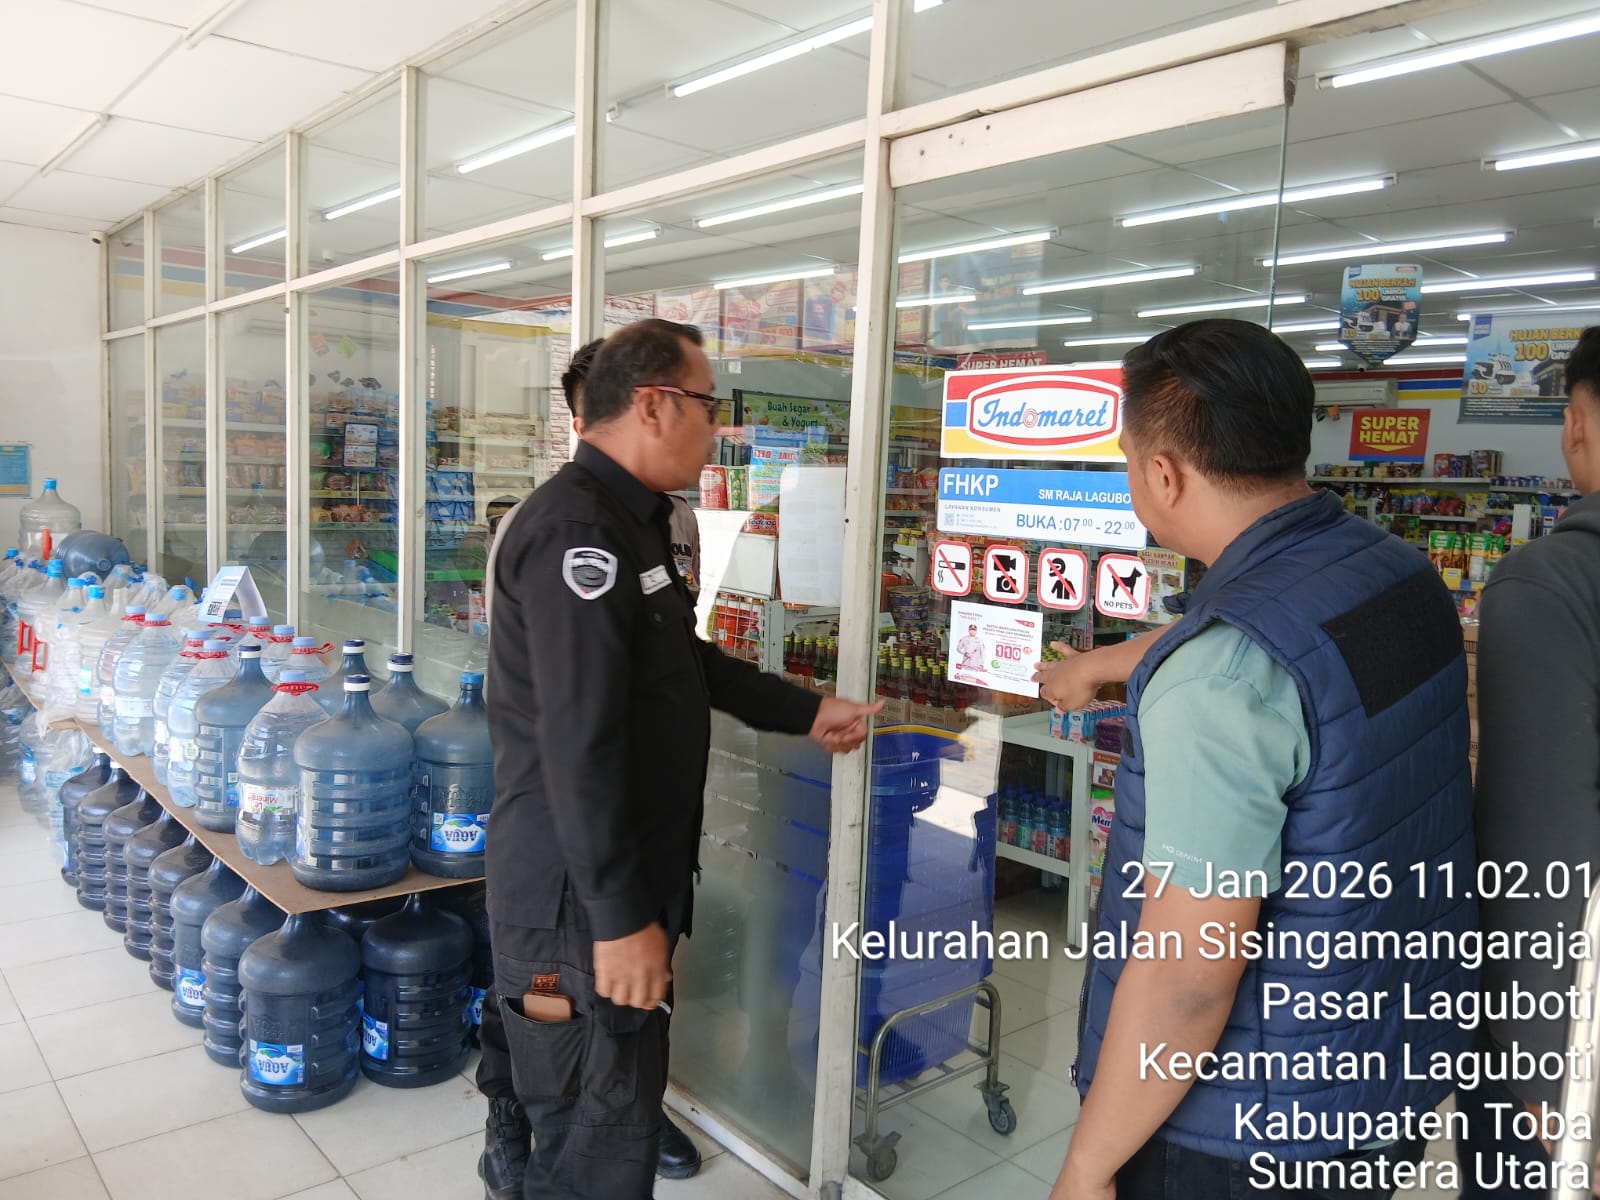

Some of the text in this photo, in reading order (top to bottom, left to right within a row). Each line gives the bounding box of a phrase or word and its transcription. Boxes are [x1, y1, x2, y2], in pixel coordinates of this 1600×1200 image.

[1357, 289, 1379, 301] 100
[1510, 329, 1549, 340] HUJAN
[1515, 343, 1549, 361] 100
[960, 357, 1043, 371] SUPER HEMAT
[1472, 382, 1487, 394] 10
[767, 401, 811, 416] Buah Segar
[978, 399, 1109, 428] Indomaret
[783, 416, 818, 431] & Yogurt
[1361, 416, 1419, 430] SUPER
[1360, 431, 1418, 444] HEMAT
[943, 473, 999, 496] FHKP
[1038, 488, 1054, 500] SM
[1055, 489, 1083, 502] RAJA
[1116, 601, 1133, 610] PETS
[996, 645, 1021, 661] 110
[445, 829, 479, 842] AQUA
[259, 1060, 290, 1074] AQUA
